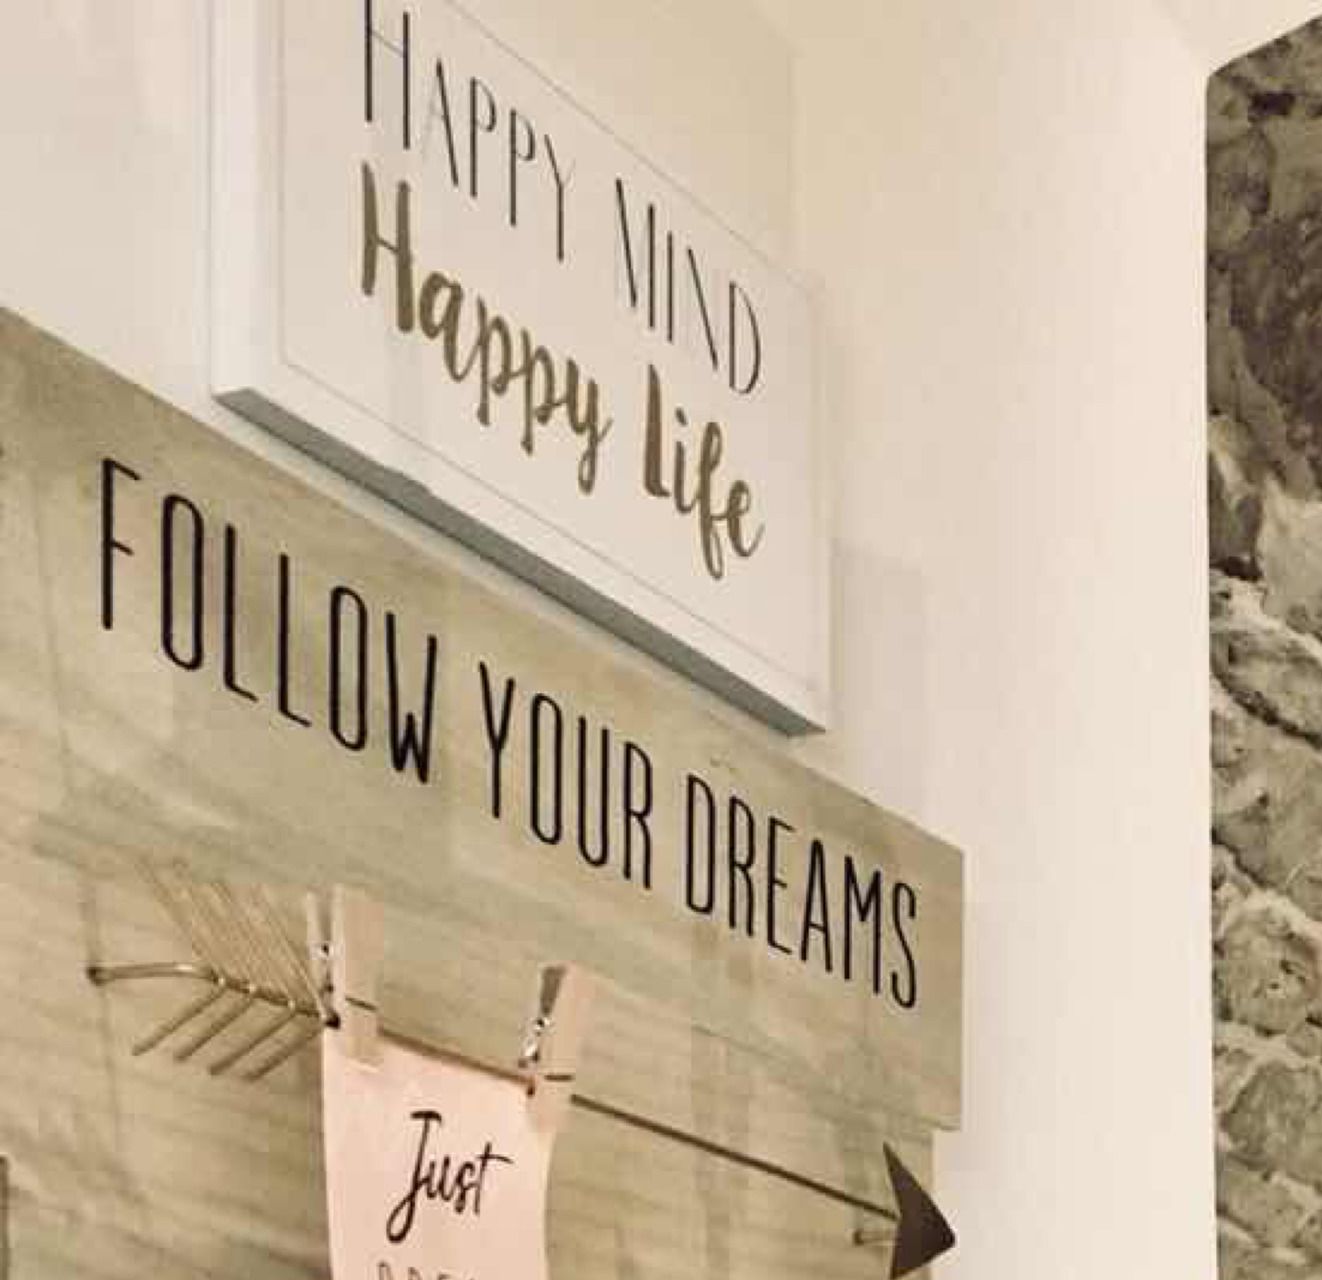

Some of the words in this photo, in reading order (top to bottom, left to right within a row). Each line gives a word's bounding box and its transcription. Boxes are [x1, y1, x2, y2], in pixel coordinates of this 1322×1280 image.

[361, 160, 612, 493] Happy
[643, 362, 764, 580] Life
[364, 0, 575, 263] HAPPY
[612, 177, 763, 395] MIND
[100, 456, 439, 785] FOLLOW
[479, 660, 655, 891] YOUR
[684, 772, 919, 1010] DREAMS
[385, 1110, 515, 1244] Just
